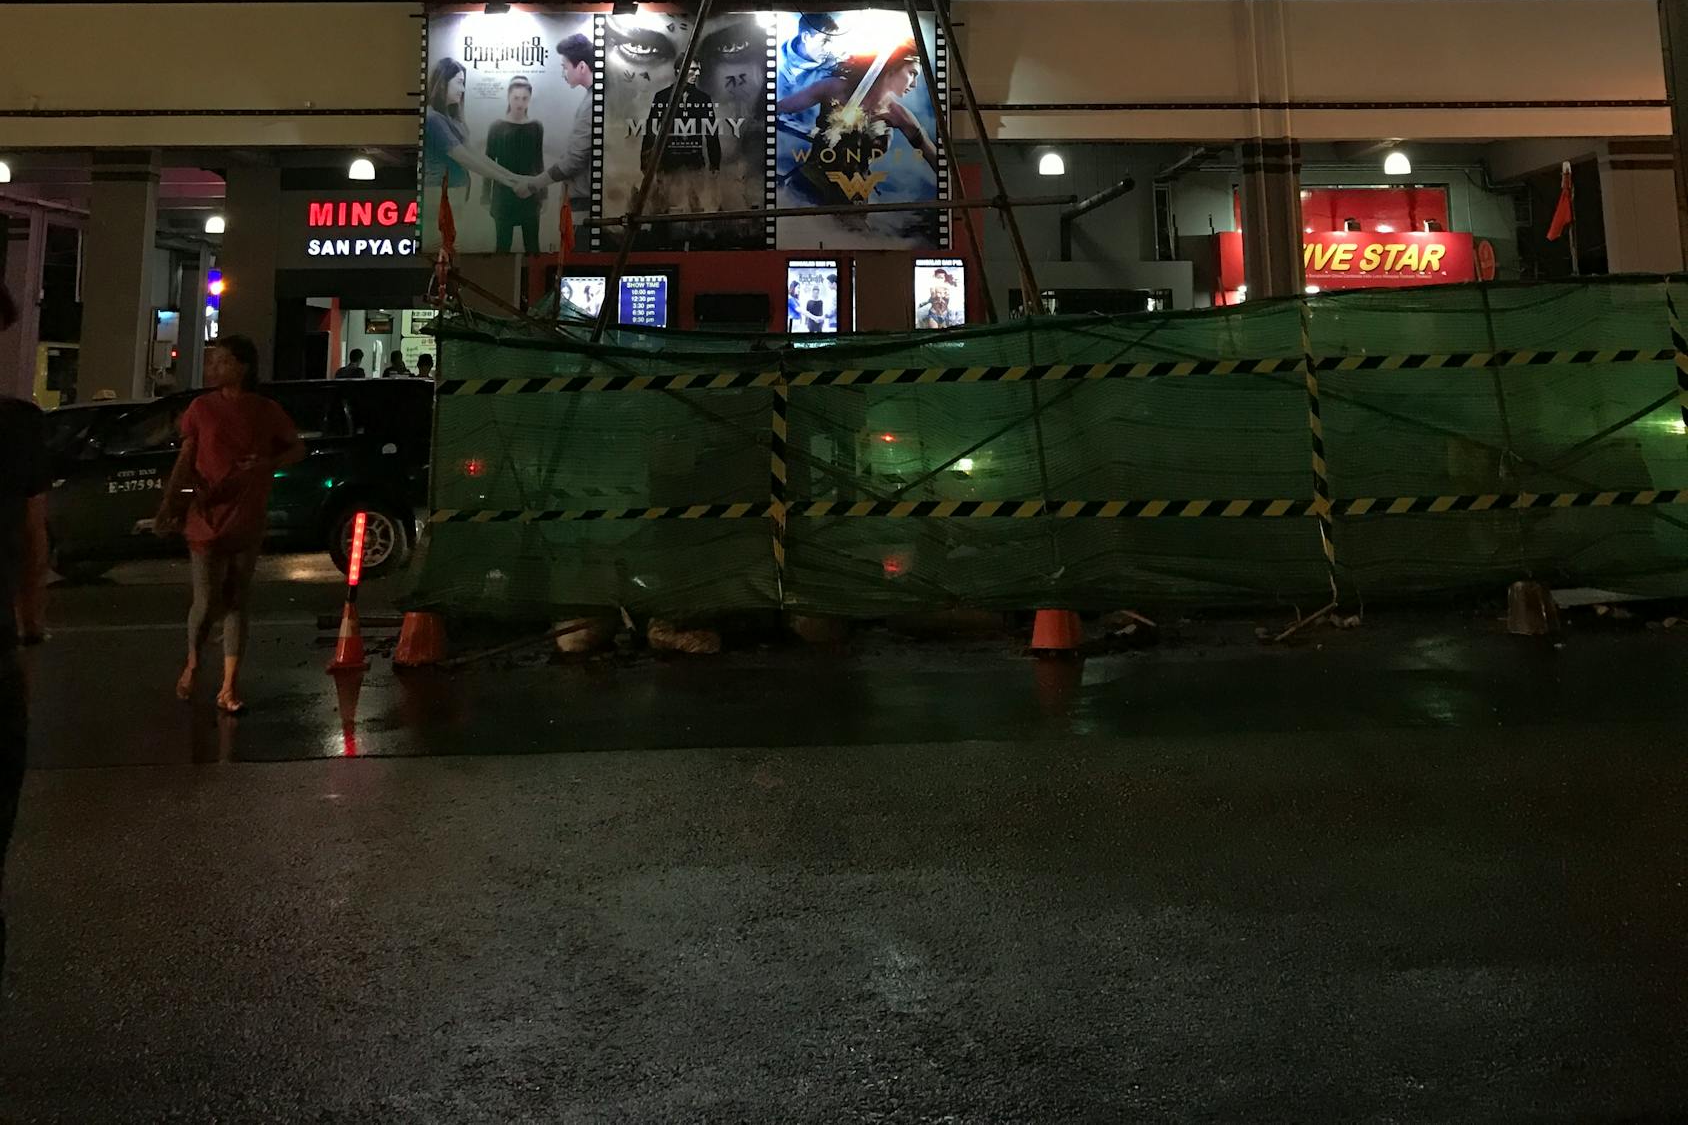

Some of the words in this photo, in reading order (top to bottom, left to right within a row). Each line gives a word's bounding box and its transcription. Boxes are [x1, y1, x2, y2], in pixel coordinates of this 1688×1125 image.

[308, 239, 350, 255] SAN
[355, 240, 393, 255] PYA
[1303, 243, 1358, 271] IVE
[1359, 243, 1446, 272] STAR
